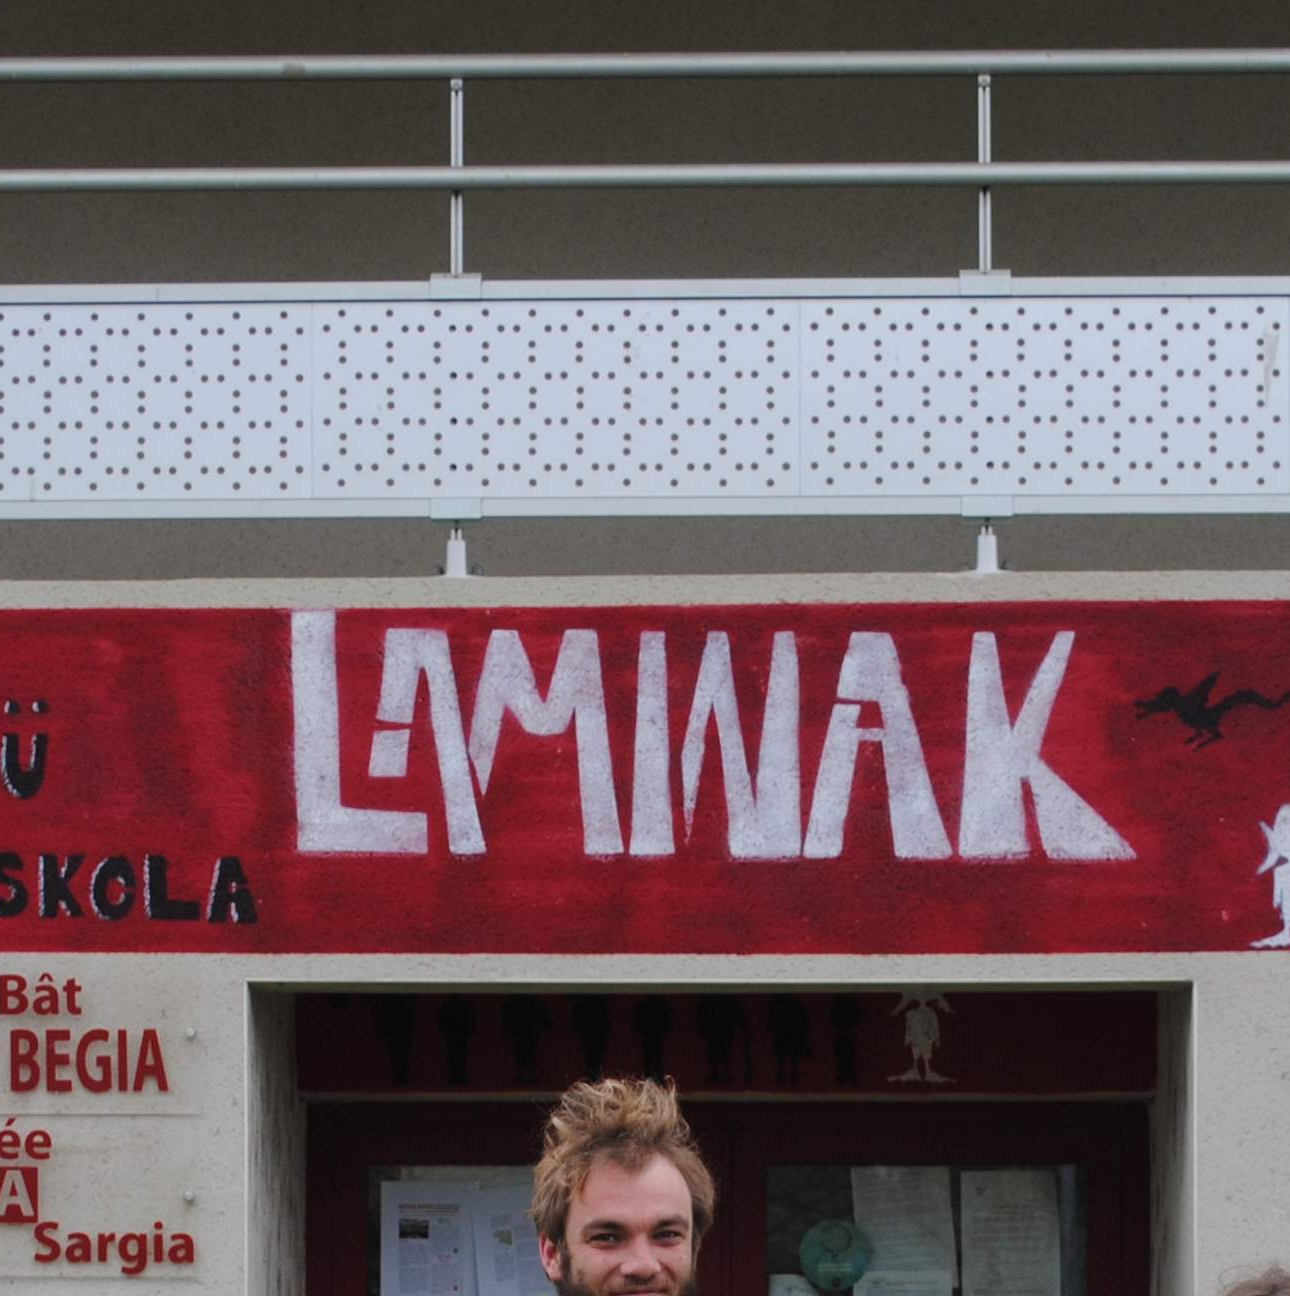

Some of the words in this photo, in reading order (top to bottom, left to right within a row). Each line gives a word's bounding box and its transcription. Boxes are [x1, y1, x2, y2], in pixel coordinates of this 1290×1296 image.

[291, 610, 1136, 860] LAMINAK
[10, 1028, 169, 1093] BEGIA
[33, 1221, 196, 1276] Sargia
